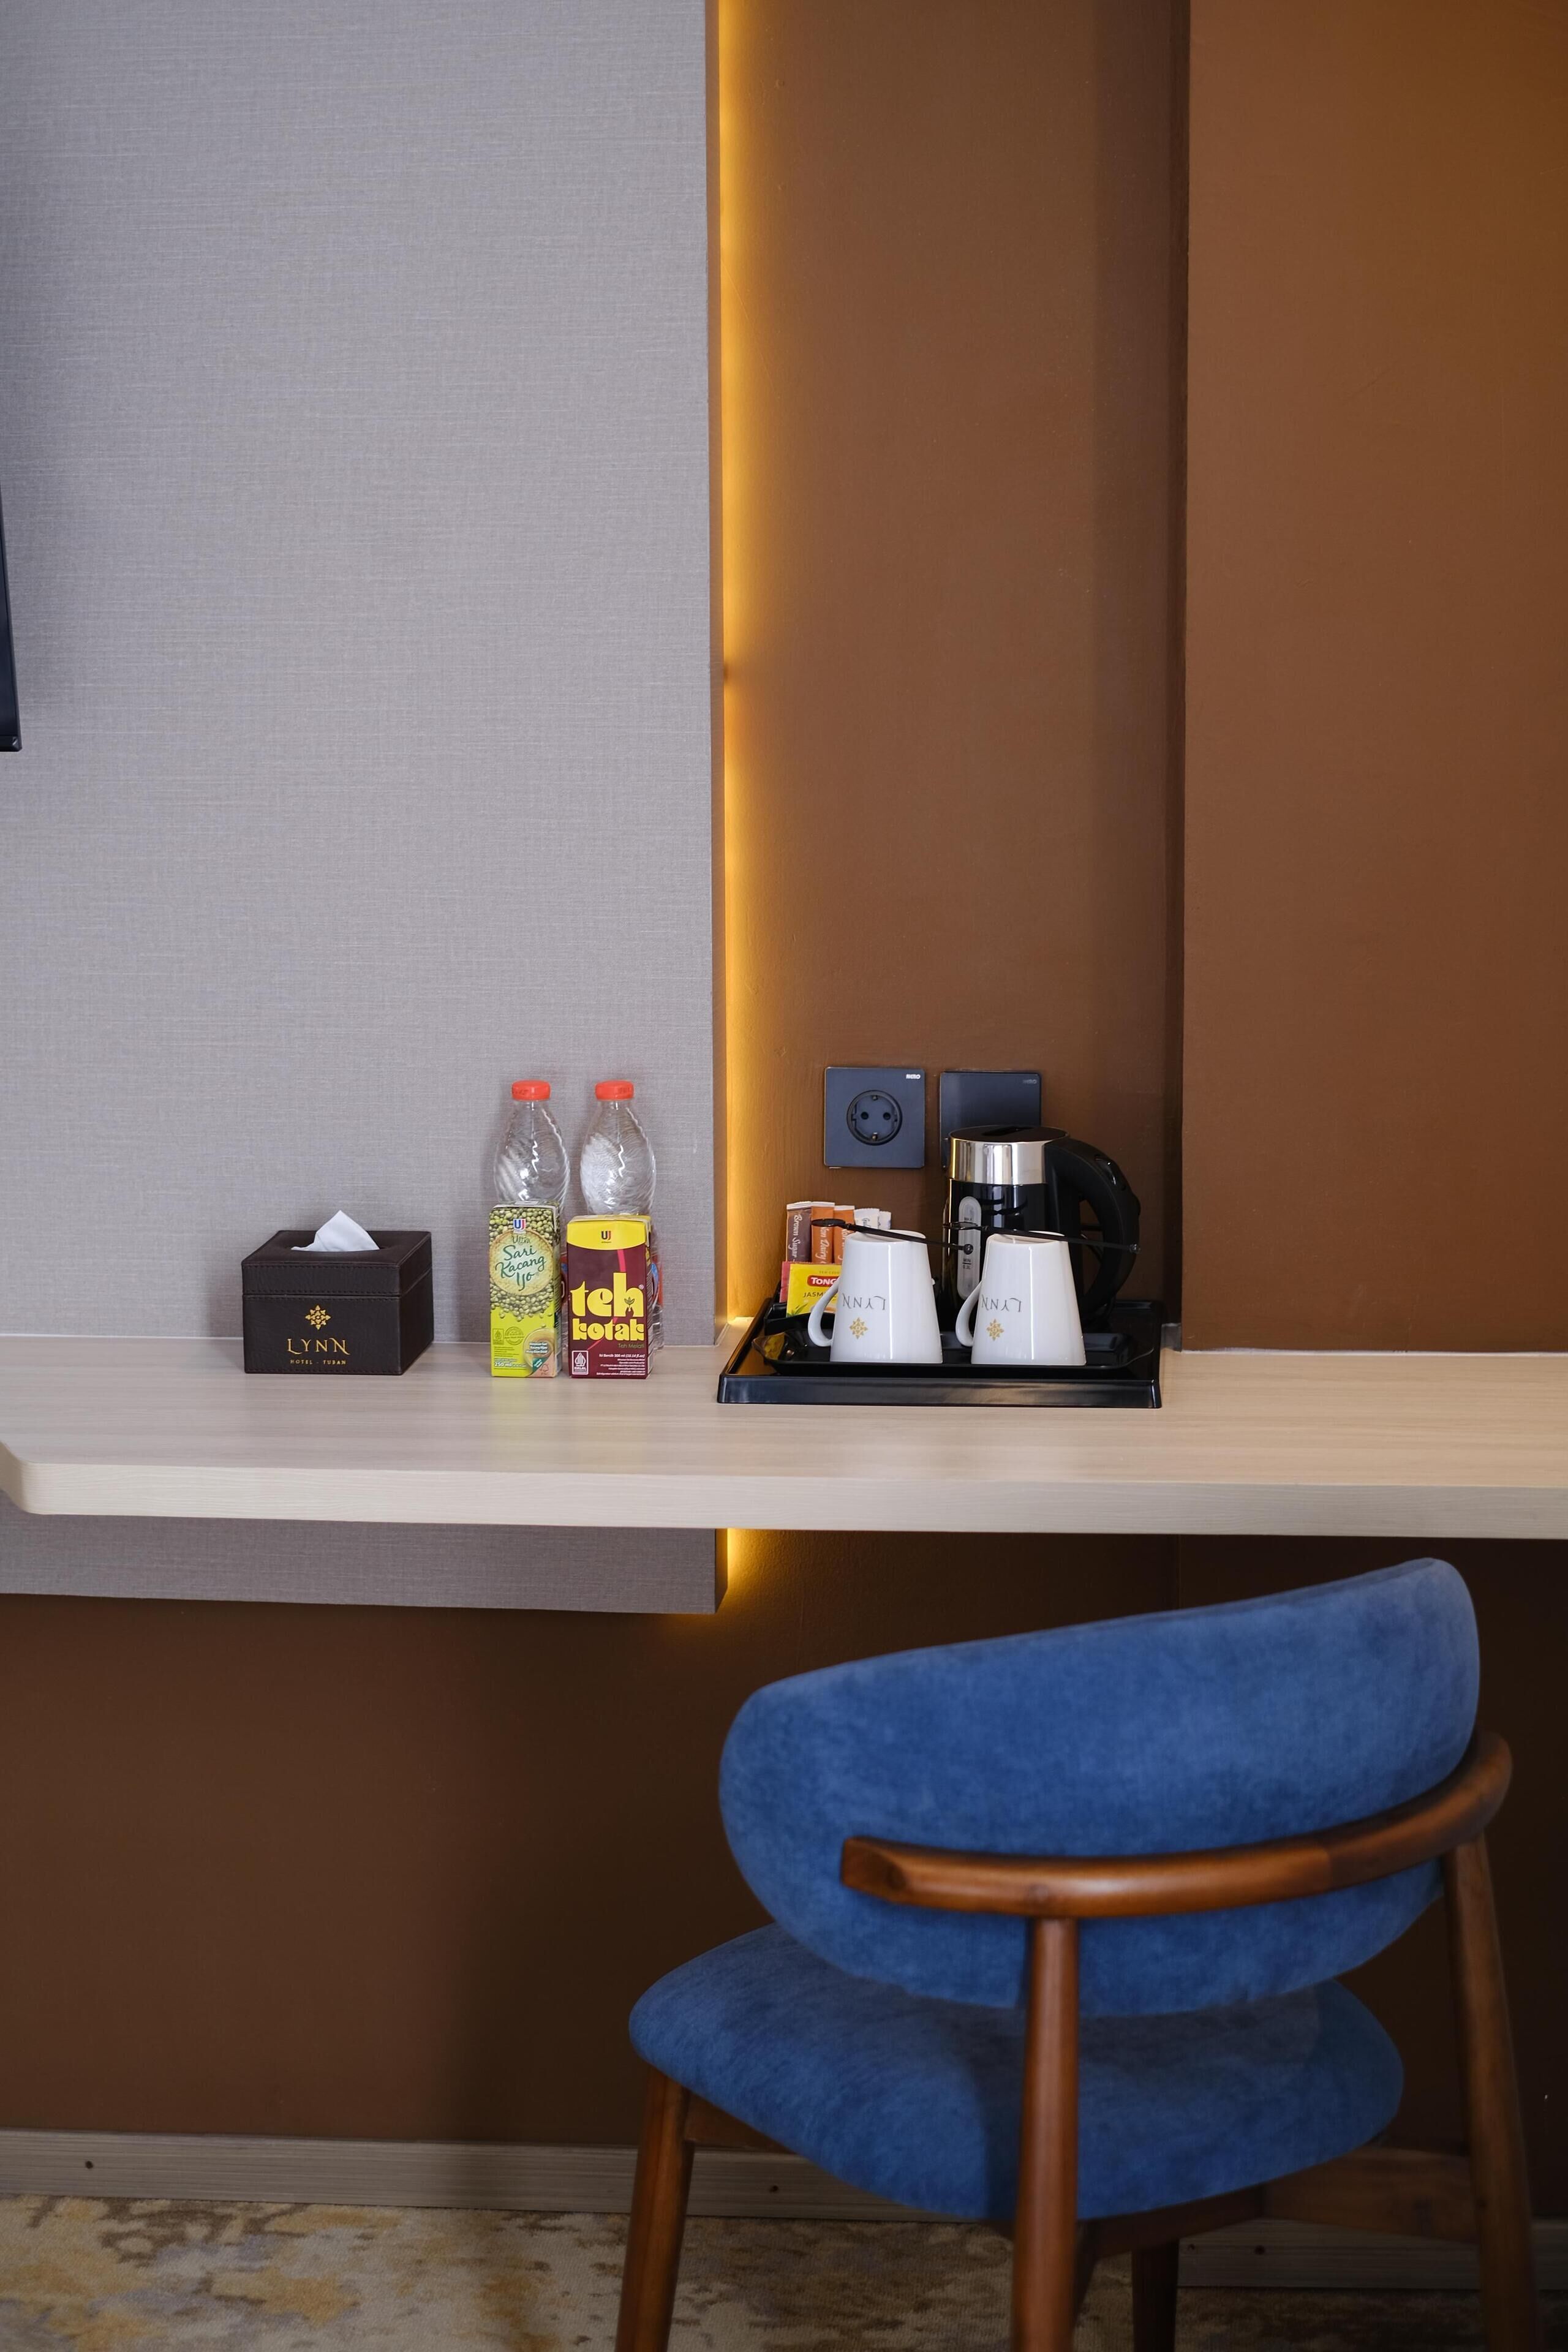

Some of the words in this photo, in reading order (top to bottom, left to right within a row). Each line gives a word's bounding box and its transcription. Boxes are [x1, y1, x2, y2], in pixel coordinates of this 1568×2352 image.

[793, 1214, 802, 1235] Brown
[503, 1245, 537, 1261] Sari
[788, 1237, 801, 1257] Sugar
[815, 1239, 829, 1261] Dairy
[496, 1256, 546, 1278] Kacang
[570, 1272, 644, 1317] teh
[842, 1293, 886, 1310] LYNN
[982, 1294, 1022, 1312] LYNN
[572, 1318, 644, 1341] kotak
[287, 1338, 350, 1355] LYNN
